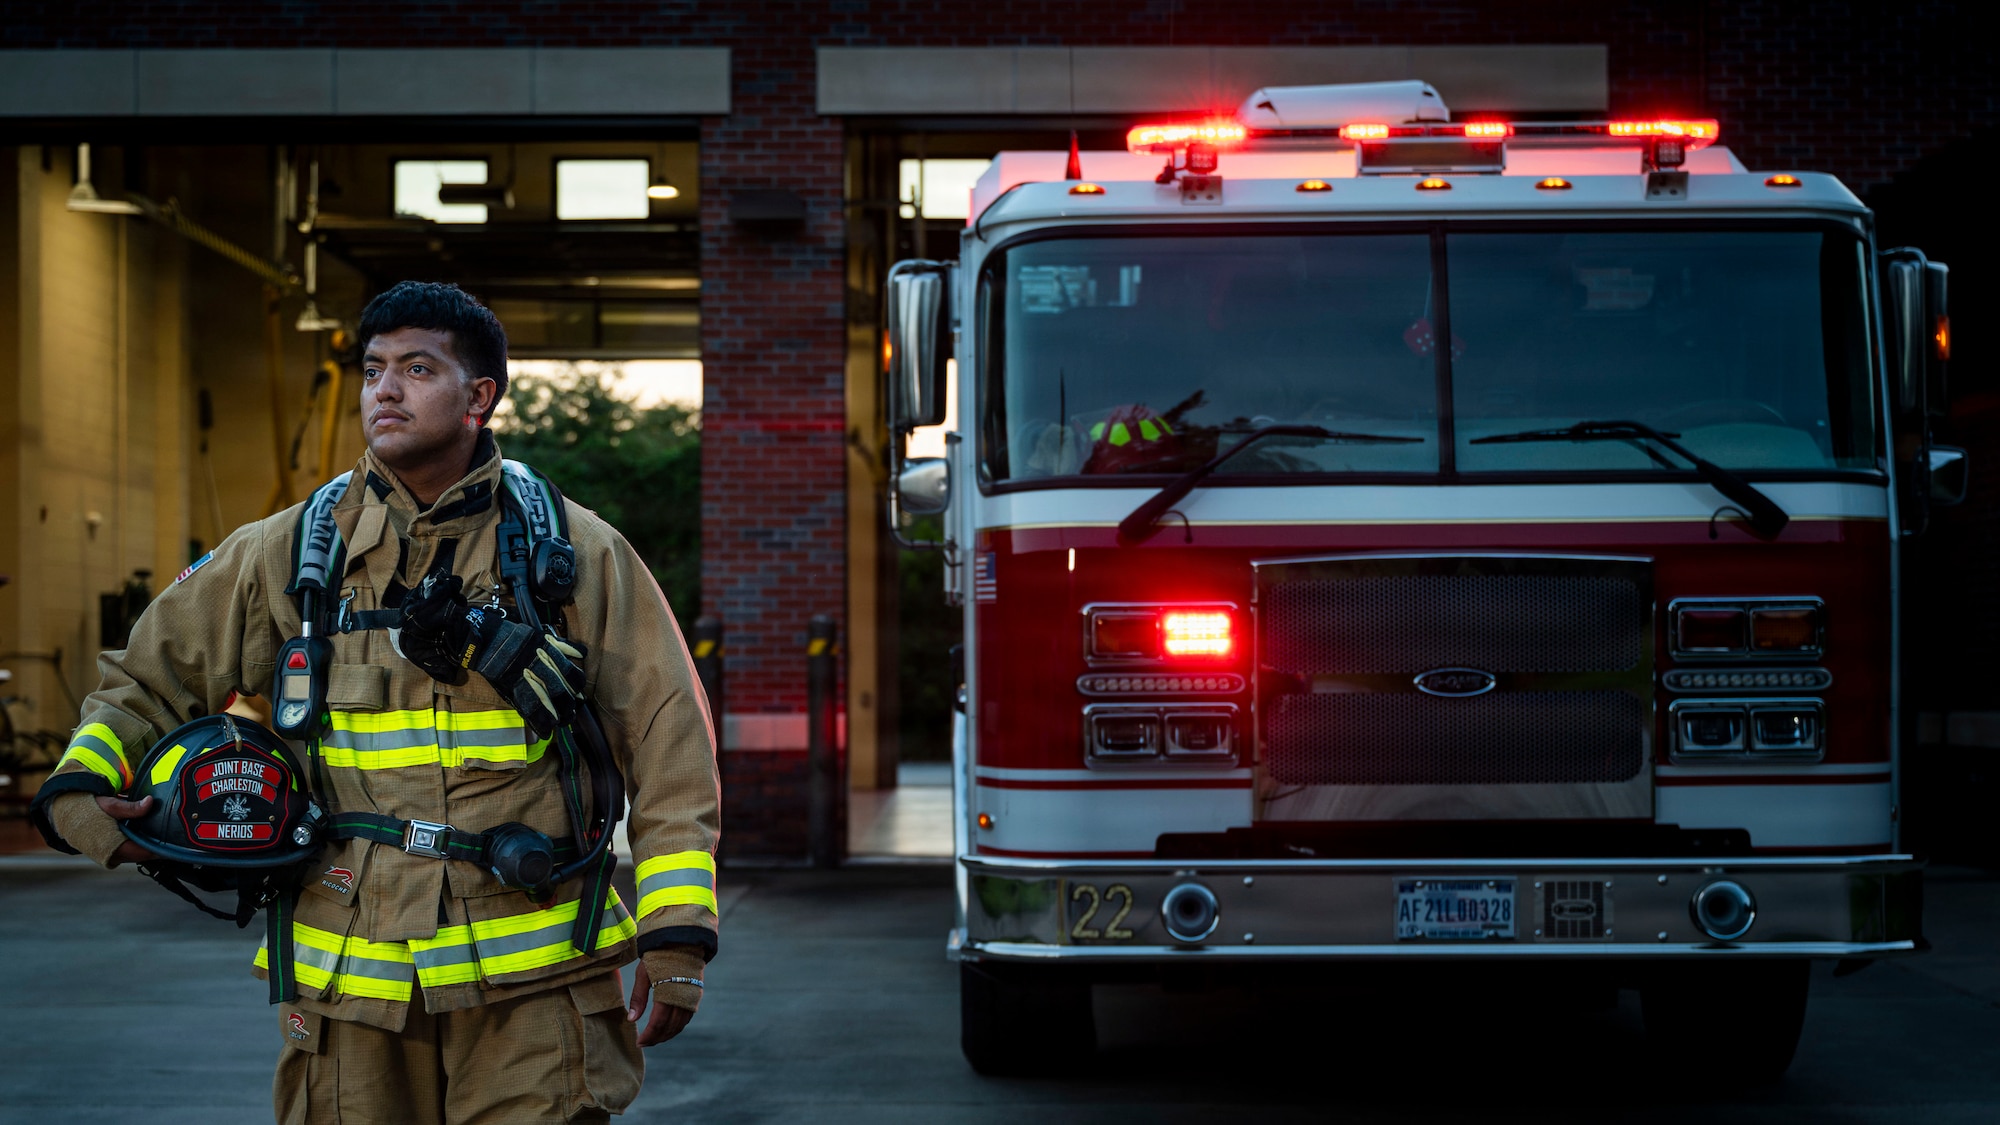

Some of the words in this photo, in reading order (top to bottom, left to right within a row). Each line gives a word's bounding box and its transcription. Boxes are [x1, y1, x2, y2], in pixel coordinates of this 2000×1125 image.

[309, 487, 341, 549] MSA
[212, 761, 240, 777] JOINT
[241, 761, 266, 778] BASE
[211, 778, 264, 795] CHARLESTON
[217, 824, 254, 839] NERIOS
[1071, 884, 1133, 939] 22
